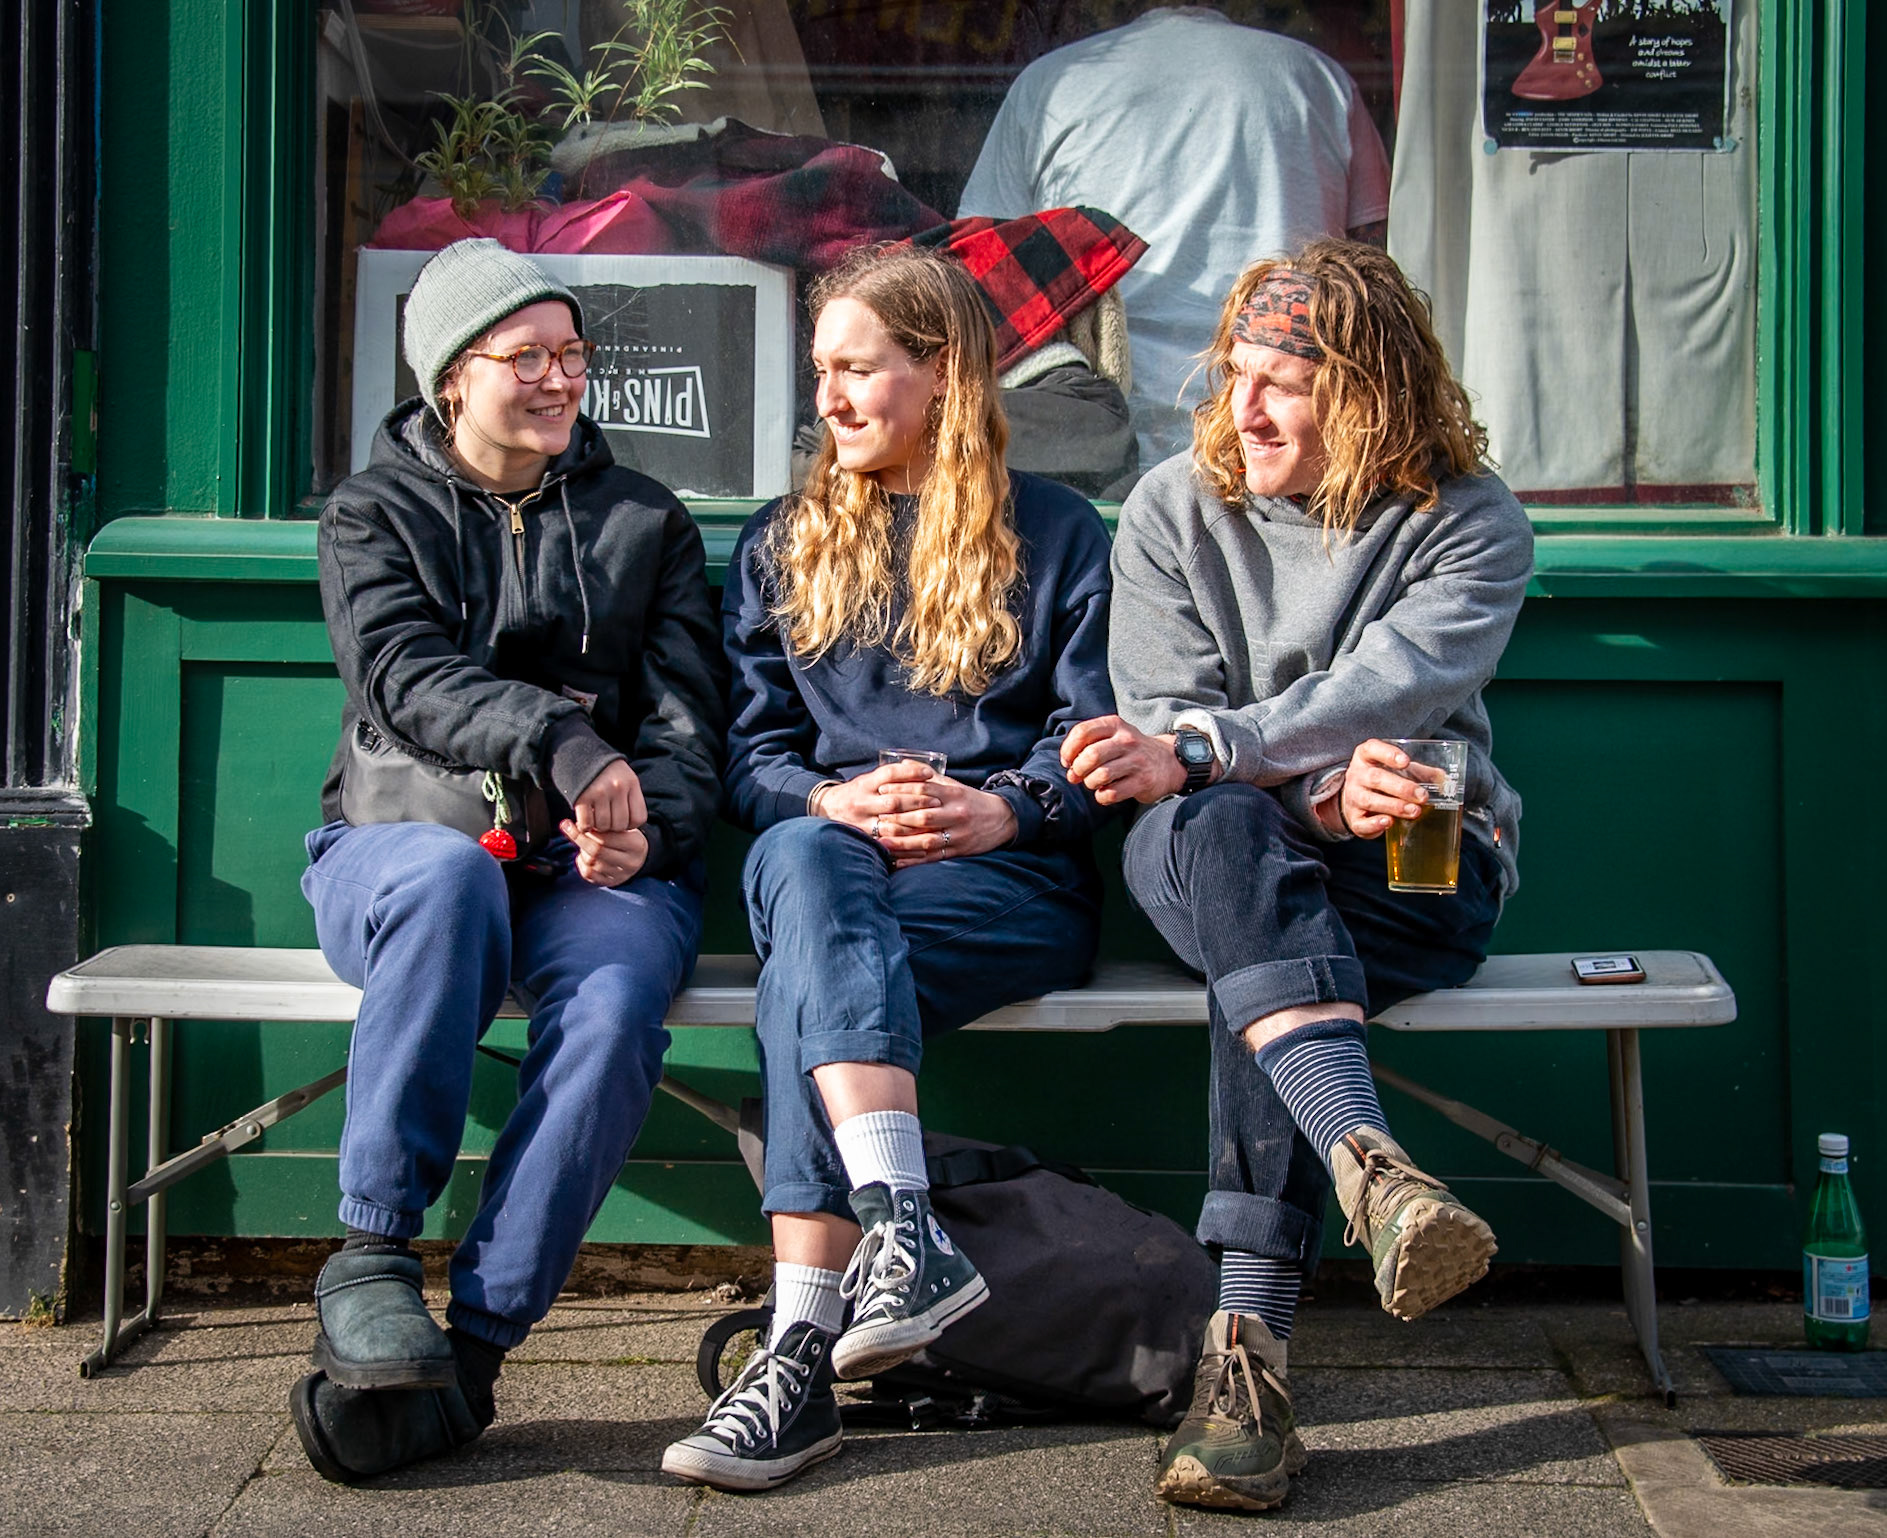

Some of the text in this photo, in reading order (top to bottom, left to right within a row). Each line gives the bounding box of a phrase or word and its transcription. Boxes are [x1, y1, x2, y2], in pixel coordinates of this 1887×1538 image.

[1628, 35, 1693, 49] A story of hopes
[1637, 48, 1685, 57] and dreams
[1632, 58, 1661, 67] amidst
[1645, 69, 1677, 81] conflict
[623, 377, 693, 427] PINS
